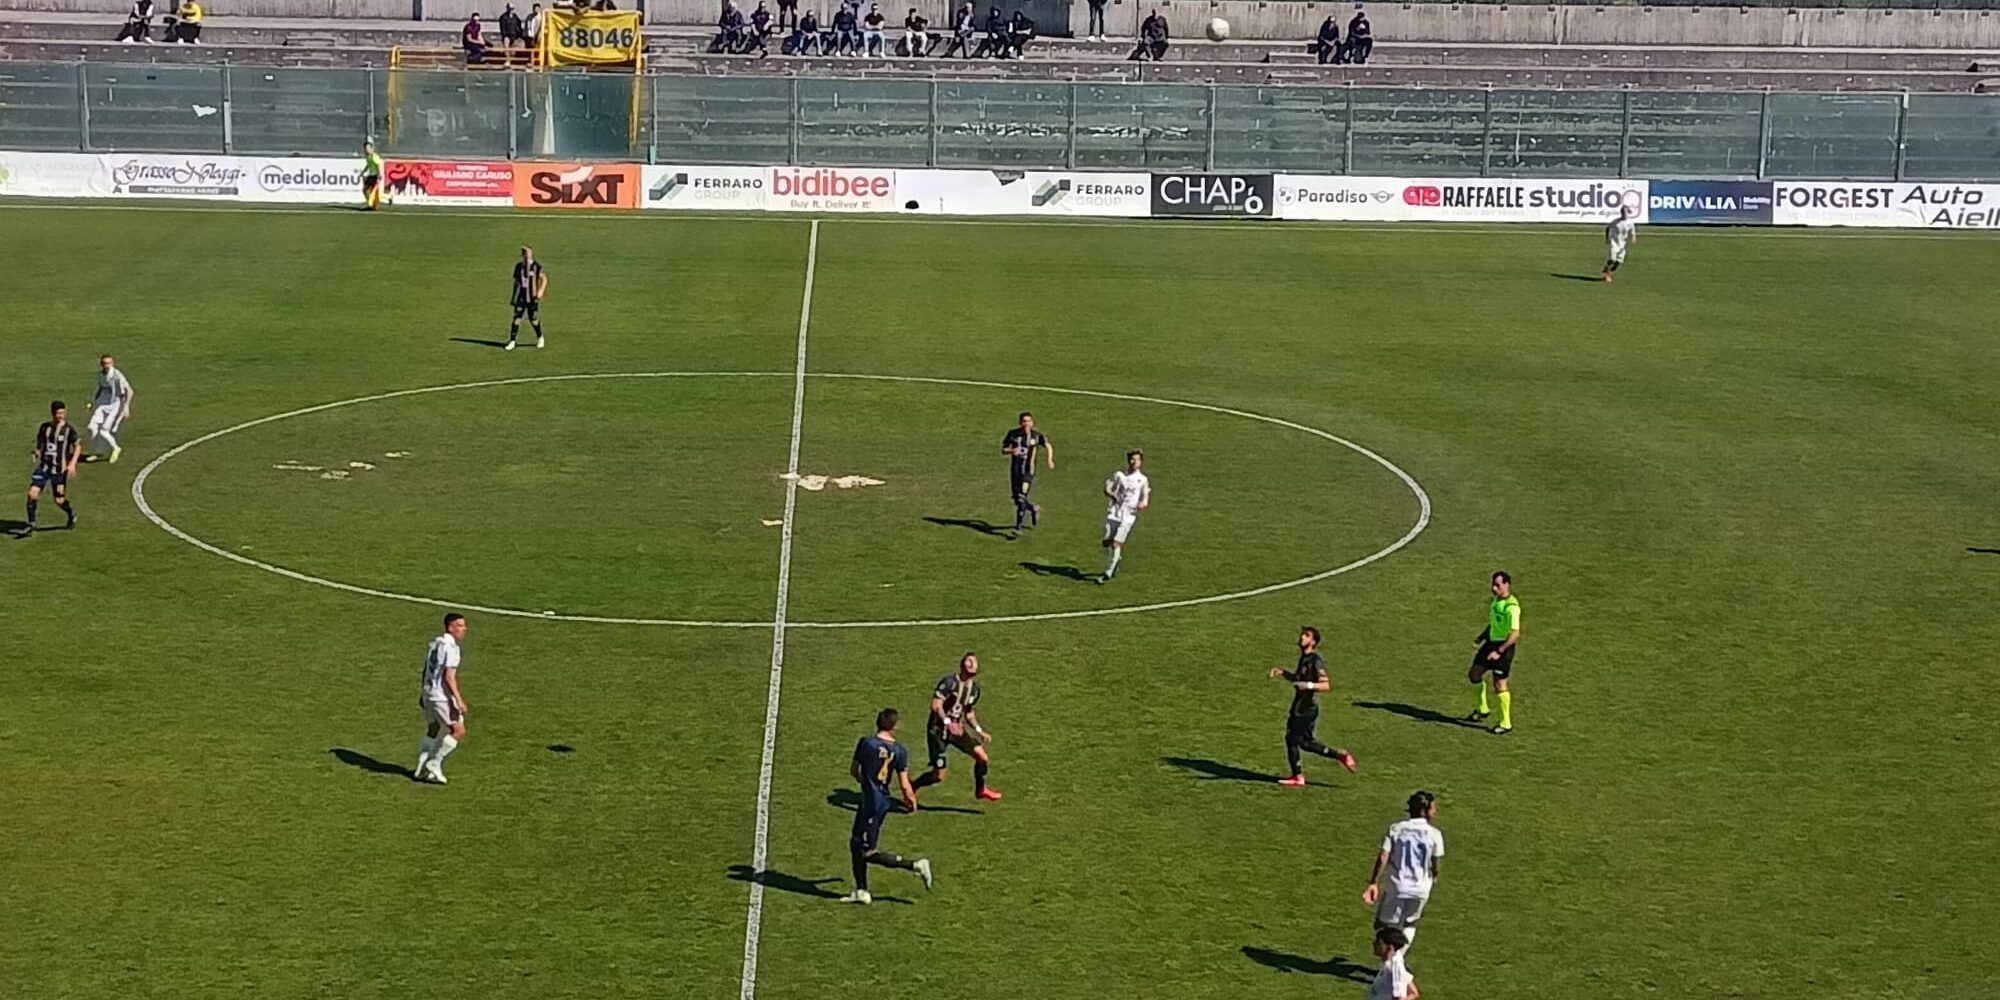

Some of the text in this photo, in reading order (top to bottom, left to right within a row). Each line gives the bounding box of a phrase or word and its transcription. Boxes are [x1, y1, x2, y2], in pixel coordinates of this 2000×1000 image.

[560, 27, 633, 48] 88046
[264, 169, 363, 186] mediolanu
[475, 171, 513, 180] CARUSO
[773, 169, 889, 197] bidibee
[531, 171, 624, 204] SIXT
[694, 178, 763, 189] FERRARO
[1076, 184, 1145, 195] FERRARO
[694, 189, 740, 200] GROUP
[1076, 195, 1122, 206] GROUP
[1298, 188, 1368, 203] Paradiso
[1443, 186, 1524, 208] RAFFAELE
[1776, 185, 1984, 208] FORGEST Auto
[790, 199, 809, 209] Buy
[825, 199, 858, 209] Deliver
[1649, 195, 1737, 210] DRIVALIA
